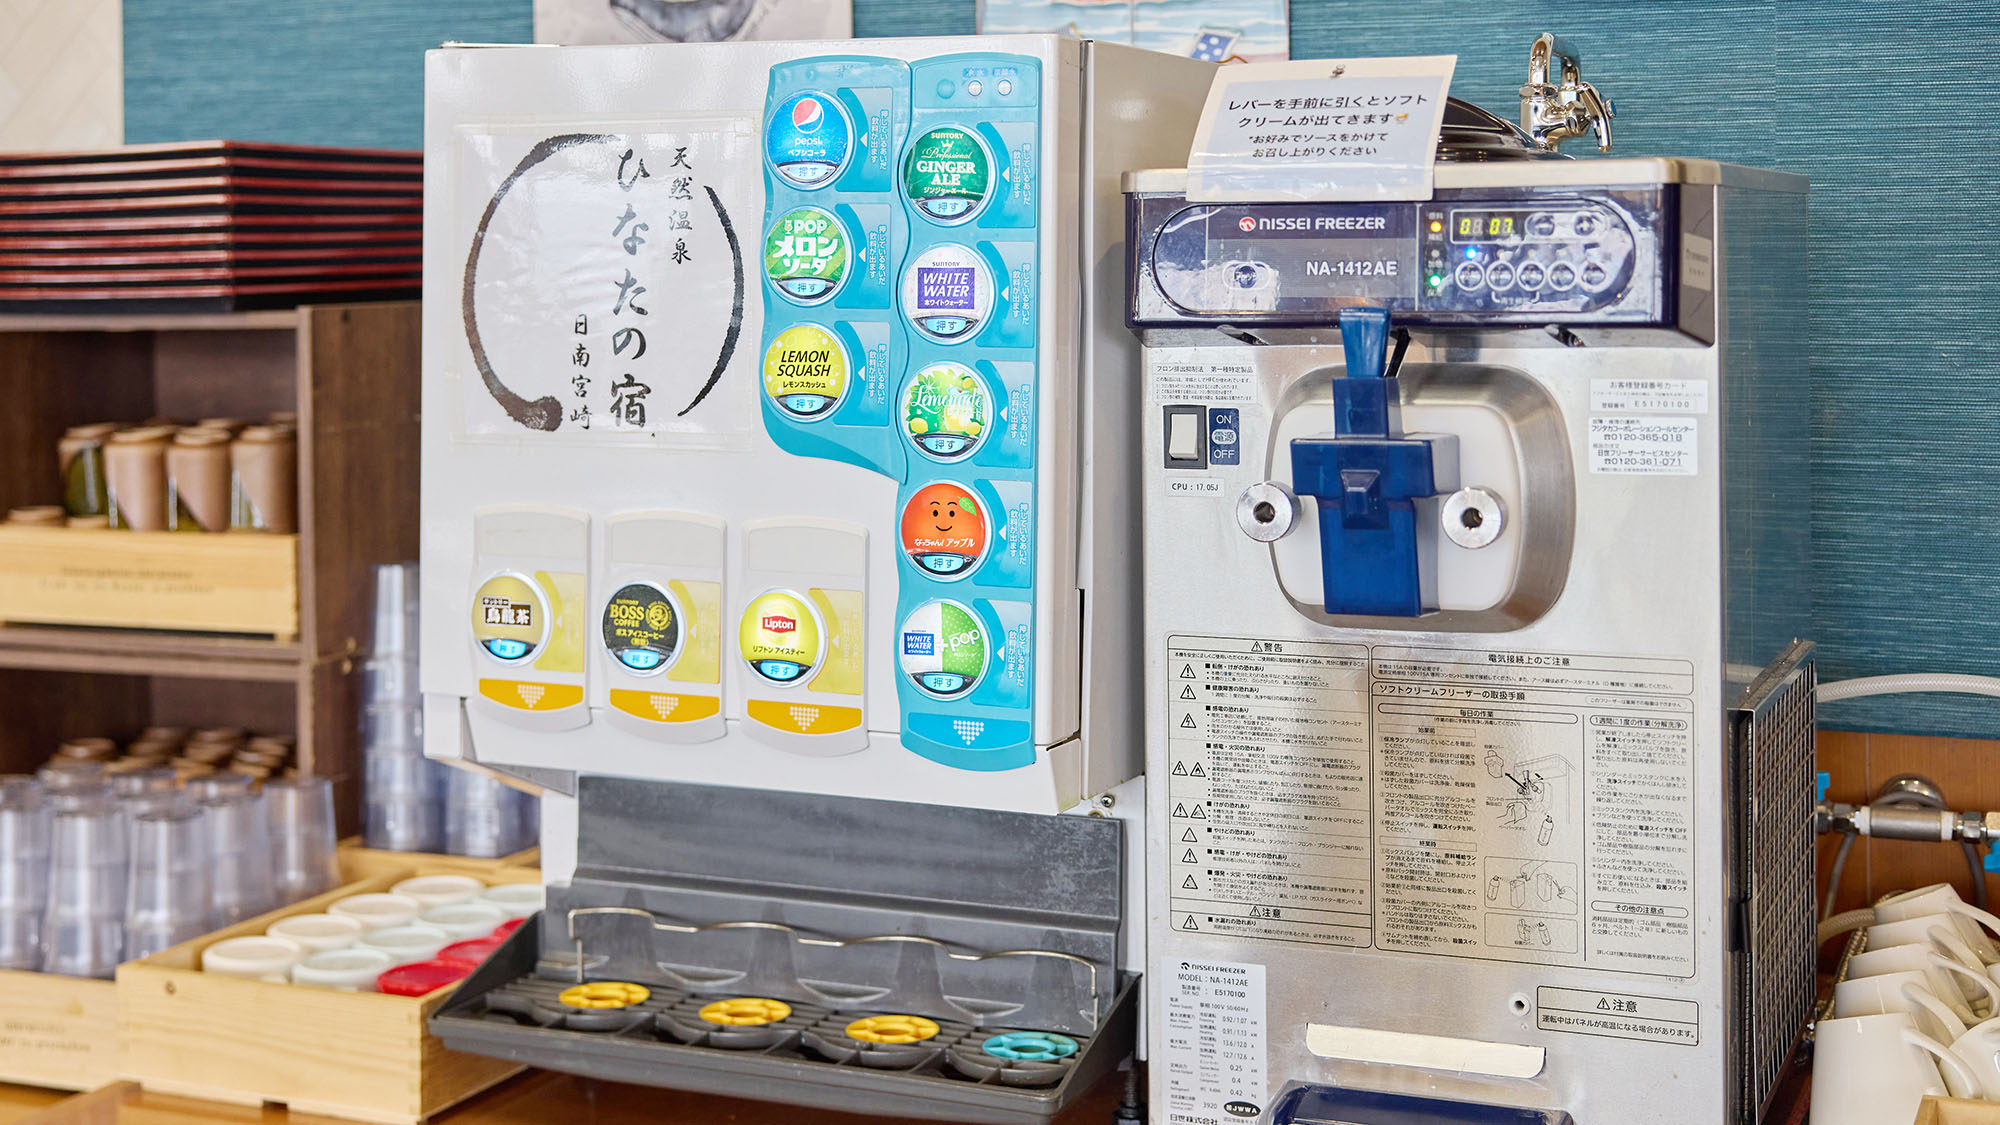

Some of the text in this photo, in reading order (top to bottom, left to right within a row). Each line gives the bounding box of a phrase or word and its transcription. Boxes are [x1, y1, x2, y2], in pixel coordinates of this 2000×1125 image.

[1228, 95, 1428, 111] レバーを手前に引くとソフト
[1238, 113, 1393, 128] クリームが出てきます
[795, 136, 821, 147] pepsi
[921, 147, 973, 160] Professional
[1252, 147, 1377, 158] お召し上がりください
[916, 161, 976, 174] GINGER
[931, 174, 960, 186] ALE
[669, 147, 693, 264] 天然温泉
[938, 202, 958, 212] 押す
[794, 220, 827, 234] POP
[1259, 217, 1386, 230] NISSEI FREEZER
[773, 235, 838, 258] メロン
[783, 256, 833, 275] ソーダ
[1306, 261, 1398, 276] NA-1412AE
[923, 272, 970, 285] WHITE
[611, 149, 651, 428] ひなたの宿
[797, 283, 817, 292] 押す
[924, 285, 970, 297] WATER
[936, 320, 957, 331] 押す
[781, 350, 829, 363] LEMON
[570, 314, 592, 429] 日南宮崎
[777, 364, 830, 378] SQUASH
[783, 381, 826, 389] レモンスカッシュ
[796, 399, 816, 409] 押す
[911, 384, 982, 414] Lemonade
[1216, 415, 1231, 424] ON
[935, 440, 955, 450] 押す
[1214, 450, 1235, 459] OFF
[933, 558, 954, 568] 押す
[609, 604, 645, 620] BOSS
[613, 619, 640, 627] COFFEE
[765, 619, 794, 630] Lipton
[907, 635, 931, 643] WHITE
[1264, 643, 1283, 652] 警告
[1488, 653, 1570, 666] 電気接続上のご注意
[771, 665, 790, 675] 押す
[934, 677, 954, 687] 押す
[1380, 685, 1525, 700] ソフトクリームフリーザーの取扱手順
[1460, 709, 1494, 717] 毎日の作業
[1214, 801, 1250, 809] けがの恐れあり
[1214, 828, 1255, 836] やけどの恐れあり
[1262, 908, 1281, 918] 注意
[1616, 905, 1665, 915] その他の注意点
[1178, 973, 1248, 986] MODEL NA-1412AE
[1214, 989, 1246, 998] E5170100
[1613, 999, 1638, 1013] 注意
[1542, 1015, 1695, 1038] 運転中はパネルが高温になる場合があります。
